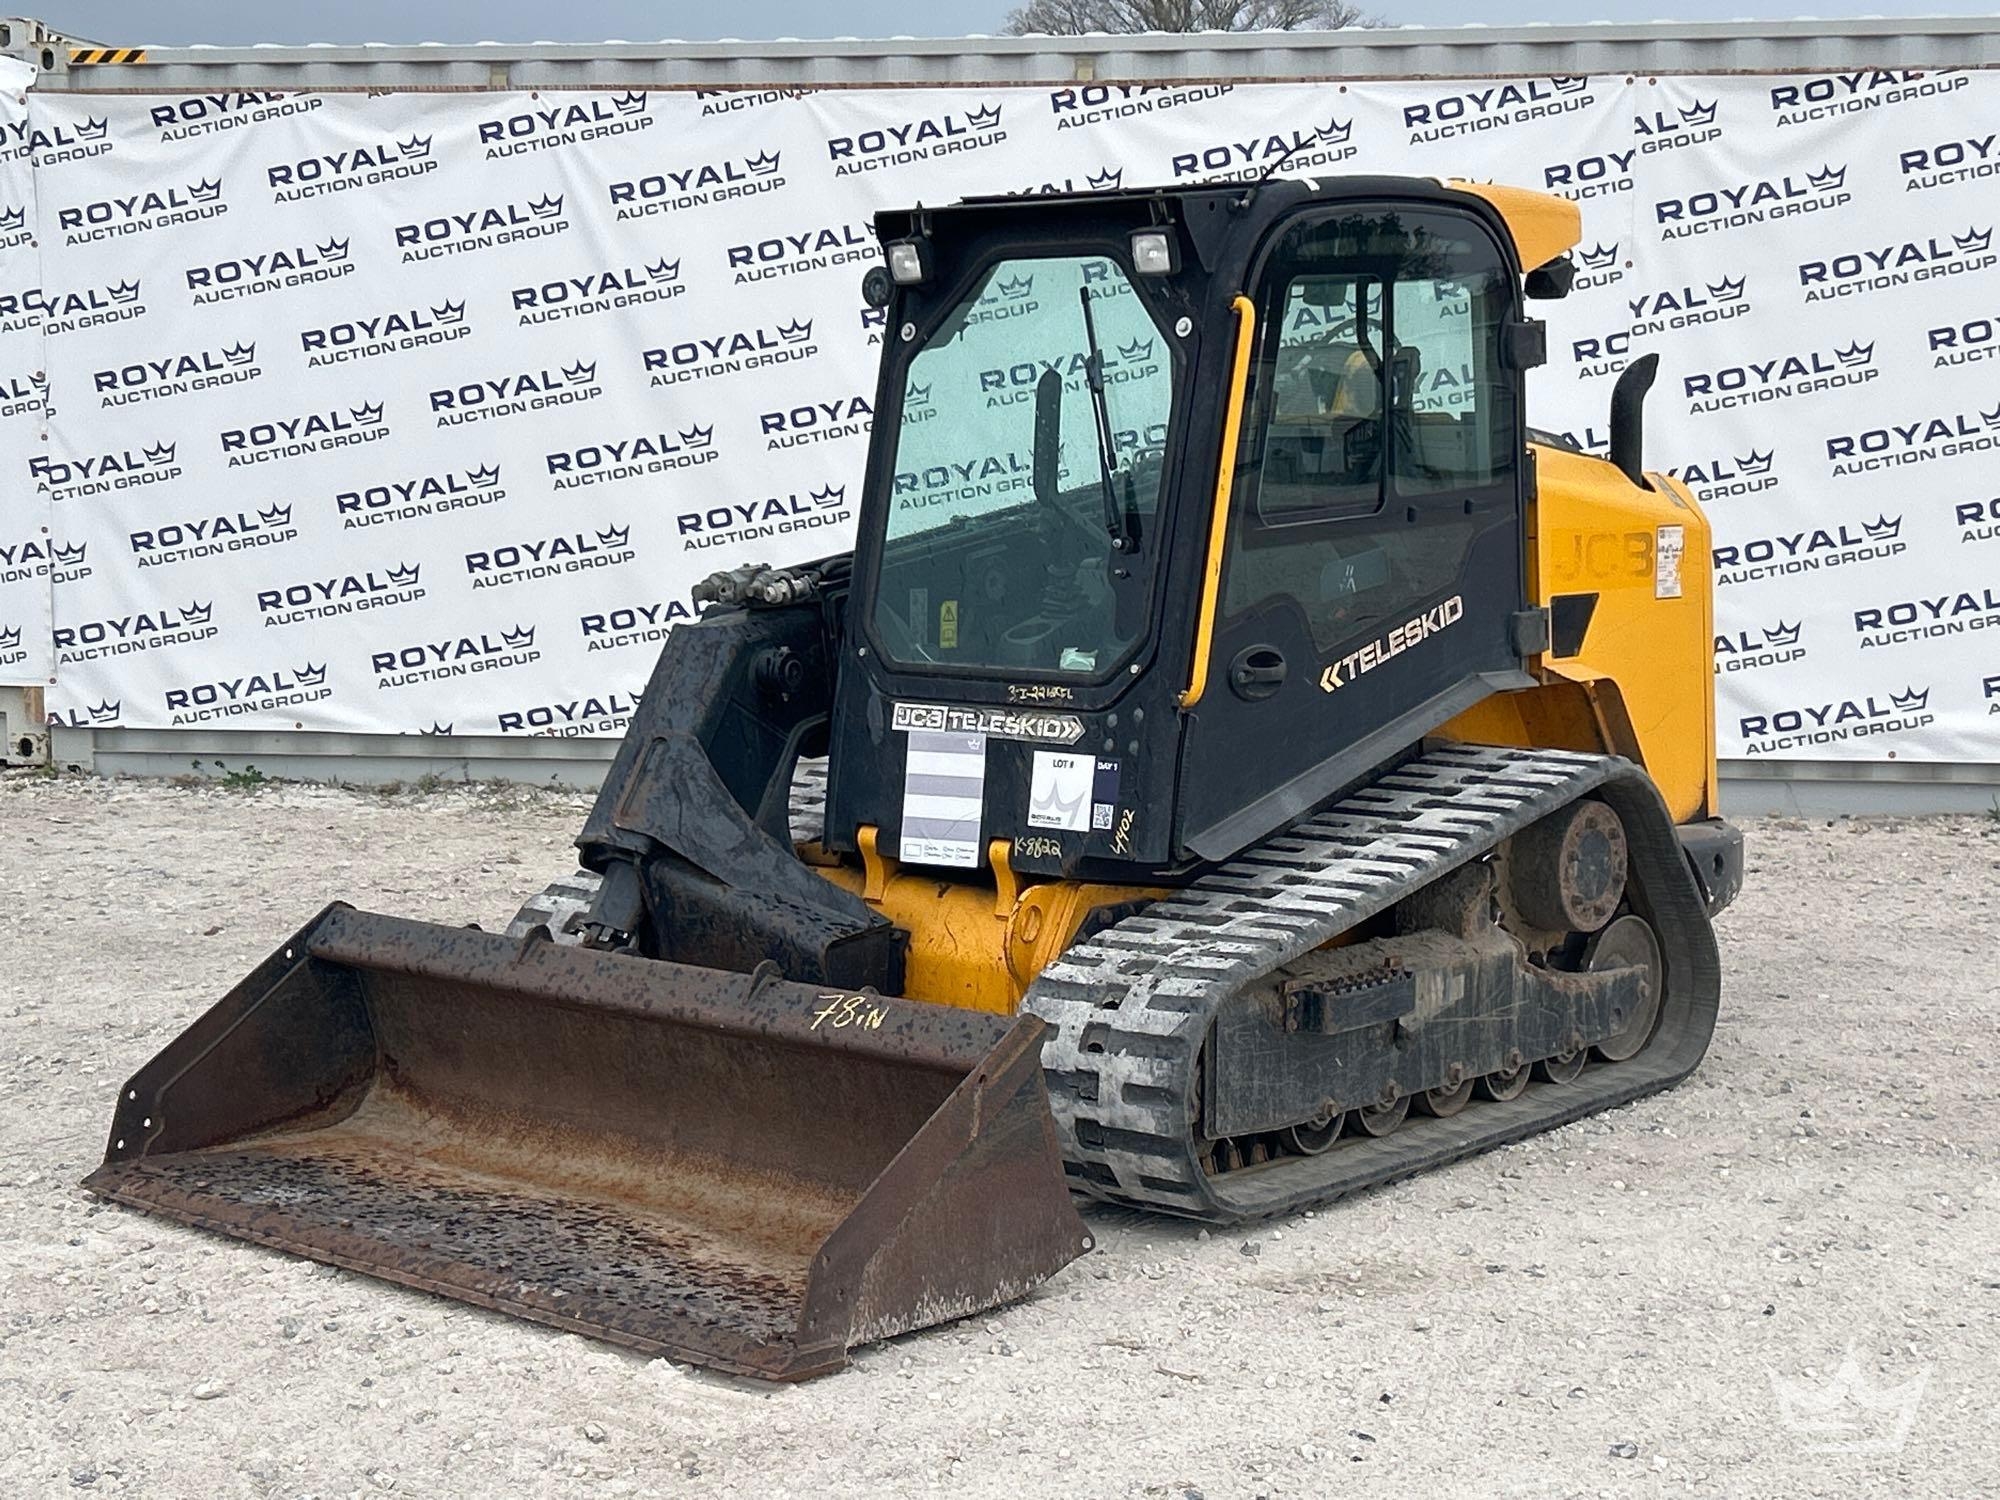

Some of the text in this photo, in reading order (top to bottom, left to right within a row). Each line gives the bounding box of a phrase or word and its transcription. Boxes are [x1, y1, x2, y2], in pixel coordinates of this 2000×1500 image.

[161, 98, 322, 143] AUCTION GROUP
[478, 101, 614, 144] ROYAL
[1057, 84, 1234, 131] AUCTION GROUP
[1403, 81, 1551, 128] ROYAL
[1409, 95, 1594, 145] AUCTION GROUP
[1777, 77, 1969, 127] AUCTION GROUP
[43, 143, 113, 166] GROUP
[486, 117, 653, 160] AUCTION GROUP
[828, 116, 966, 161] ROYAL
[835, 131, 1007, 177] AUCTION GROUP
[1172, 130, 1316, 177] ROYAL
[1279, 146, 1357, 172] GROUP
[1641, 128, 1721, 154] GROUP
[268, 145, 399, 188] ROYAL
[274, 161, 438, 204] AUCTION GROUP
[609, 161, 746, 205] ROYAL
[1906, 163, 2000, 192] AUCTIO
[58, 189, 188, 230] ROYAL
[616, 177, 786, 221] AUCTION GROUP
[1655, 177, 1807, 224] ROYAL
[1661, 193, 1851, 241] AUCTION GROUP
[66, 204, 228, 247] AUCTION GROUP
[395, 205, 530, 247] ROYAL
[402, 221, 569, 264] AUCTION GROUP
[727, 225, 865, 268] ROYAL
[1799, 238, 1953, 286] ROYAL
[186, 248, 318, 290] ROYAL
[193, 264, 355, 306] AUCTION GROUP
[512, 268, 647, 310] ROYAL
[734, 256, 827, 285] AUCTION
[1805, 255, 1997, 303] AUCTION GROUP
[79, 305, 146, 328] GROUP
[519, 285, 685, 327] AUCTION GROUP
[1669, 304, 1750, 329] GROUP
[301, 310, 433, 352] ROYAL
[308, 326, 471, 368] AUCTION GROUP
[642, 329, 778, 371] ROYAL
[94, 352, 224, 392] ROYAL
[650, 345, 818, 388] AUCTION GROUP
[1683, 352, 1835, 398] ROYAL
[101, 368, 261, 408] AUCTION GROUP
[429, 371, 563, 412] ROYAL
[437, 387, 602, 428] AUCTION GROUP
[1690, 369, 1879, 415] AUCTION GROUP
[220, 411, 352, 452] ROYAL
[760, 396, 874, 435] ROYA
[228, 428, 390, 468] AUCTION GROUP
[546, 434, 681, 475] ROYAL
[767, 423, 859, 451] AUCTION
[1826, 415, 1980, 460] ROYAL
[114, 467, 182, 489] GROUP
[554, 451, 719, 491] AUCTION GROUP
[894, 453, 1031, 496] ROYAL
[1832, 447, 1936, 477] AUCTION
[336, 474, 468, 514] ROYAL
[900, 483, 993, 511] AUCTION
[1699, 477, 1778, 501] GROUP
[344, 490, 506, 530] AUCTION GROUP
[677, 495, 812, 535] ROYAL
[130, 514, 260, 553] ROYAL
[138, 529, 297, 568] AUCTION GROUP
[684, 511, 851, 551] AUCTION GROUP
[1712, 526, 1863, 569] ROYAL
[465, 534, 598, 574] ROYAL
[473, 551, 635, 590] AUCTION GROUP
[1555, 532, 1651, 581] JCB
[1718, 542, 1906, 586] AUCTION GROUP
[257, 572, 388, 612] ROYAL
[265, 588, 426, 627] AUCTION GROUP
[52, 610, 181, 649] ROYAL
[60, 627, 218, 665] AUCTION GROUP
[1342, 595, 1463, 681] TELESKID
[1860, 621, 1964, 649] AUCTION
[371, 635, 503, 674] ROYAL
[378, 651, 541, 689] AUCTION GROUP
[1726, 648, 1806, 672] GROUP
[165, 672, 294, 711] ROYAL
[171, 688, 332, 726] AUCTION GROUP
[498, 695, 630, 733] ROYAL
[897, 707, 1060, 737] JCB TELESKID
[1740, 697, 1890, 738] ROYAL
[1746, 714, 1934, 755] AUCTION GROUP
[1053, 759, 1068, 768] LOT
[1097, 762, 1113, 770] DAY
